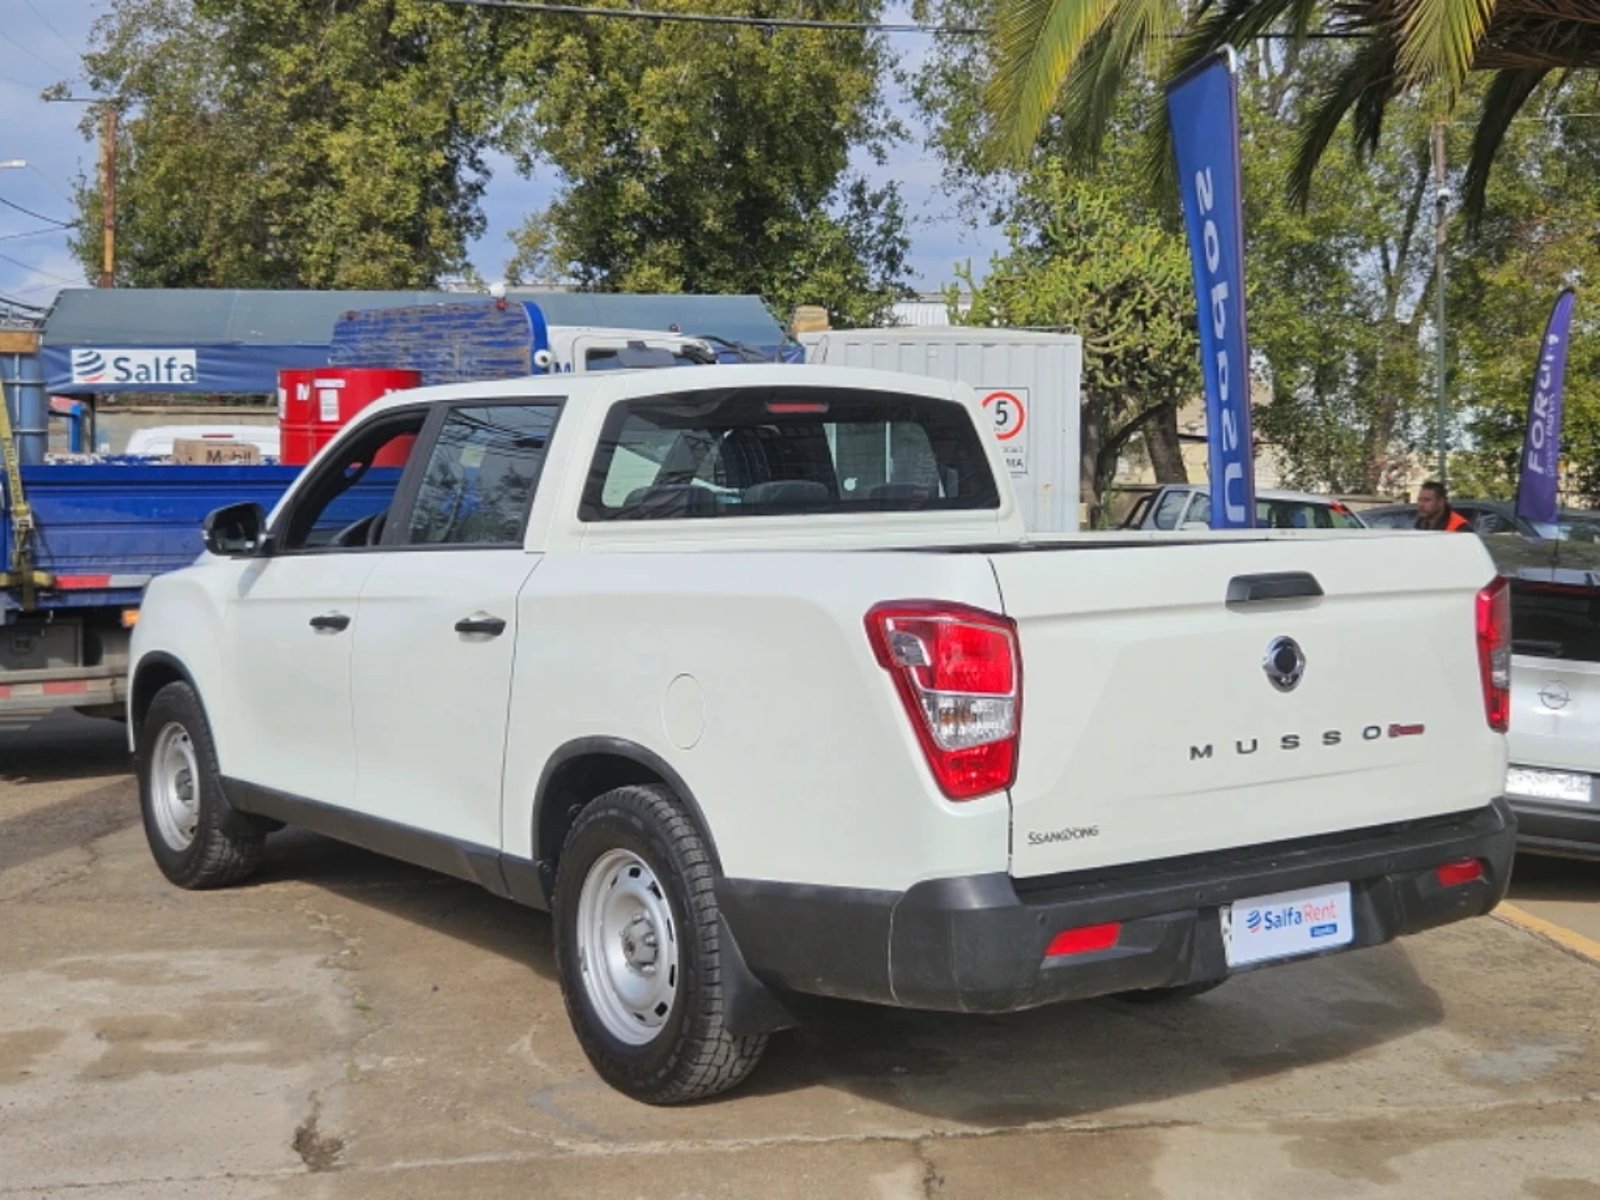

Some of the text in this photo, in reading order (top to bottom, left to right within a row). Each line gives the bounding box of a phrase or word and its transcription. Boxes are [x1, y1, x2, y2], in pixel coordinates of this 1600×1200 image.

[112, 356, 195, 382] Salfa
[994, 400, 1009, 426] 5
[1189, 724, 1383, 761] MUSSO
